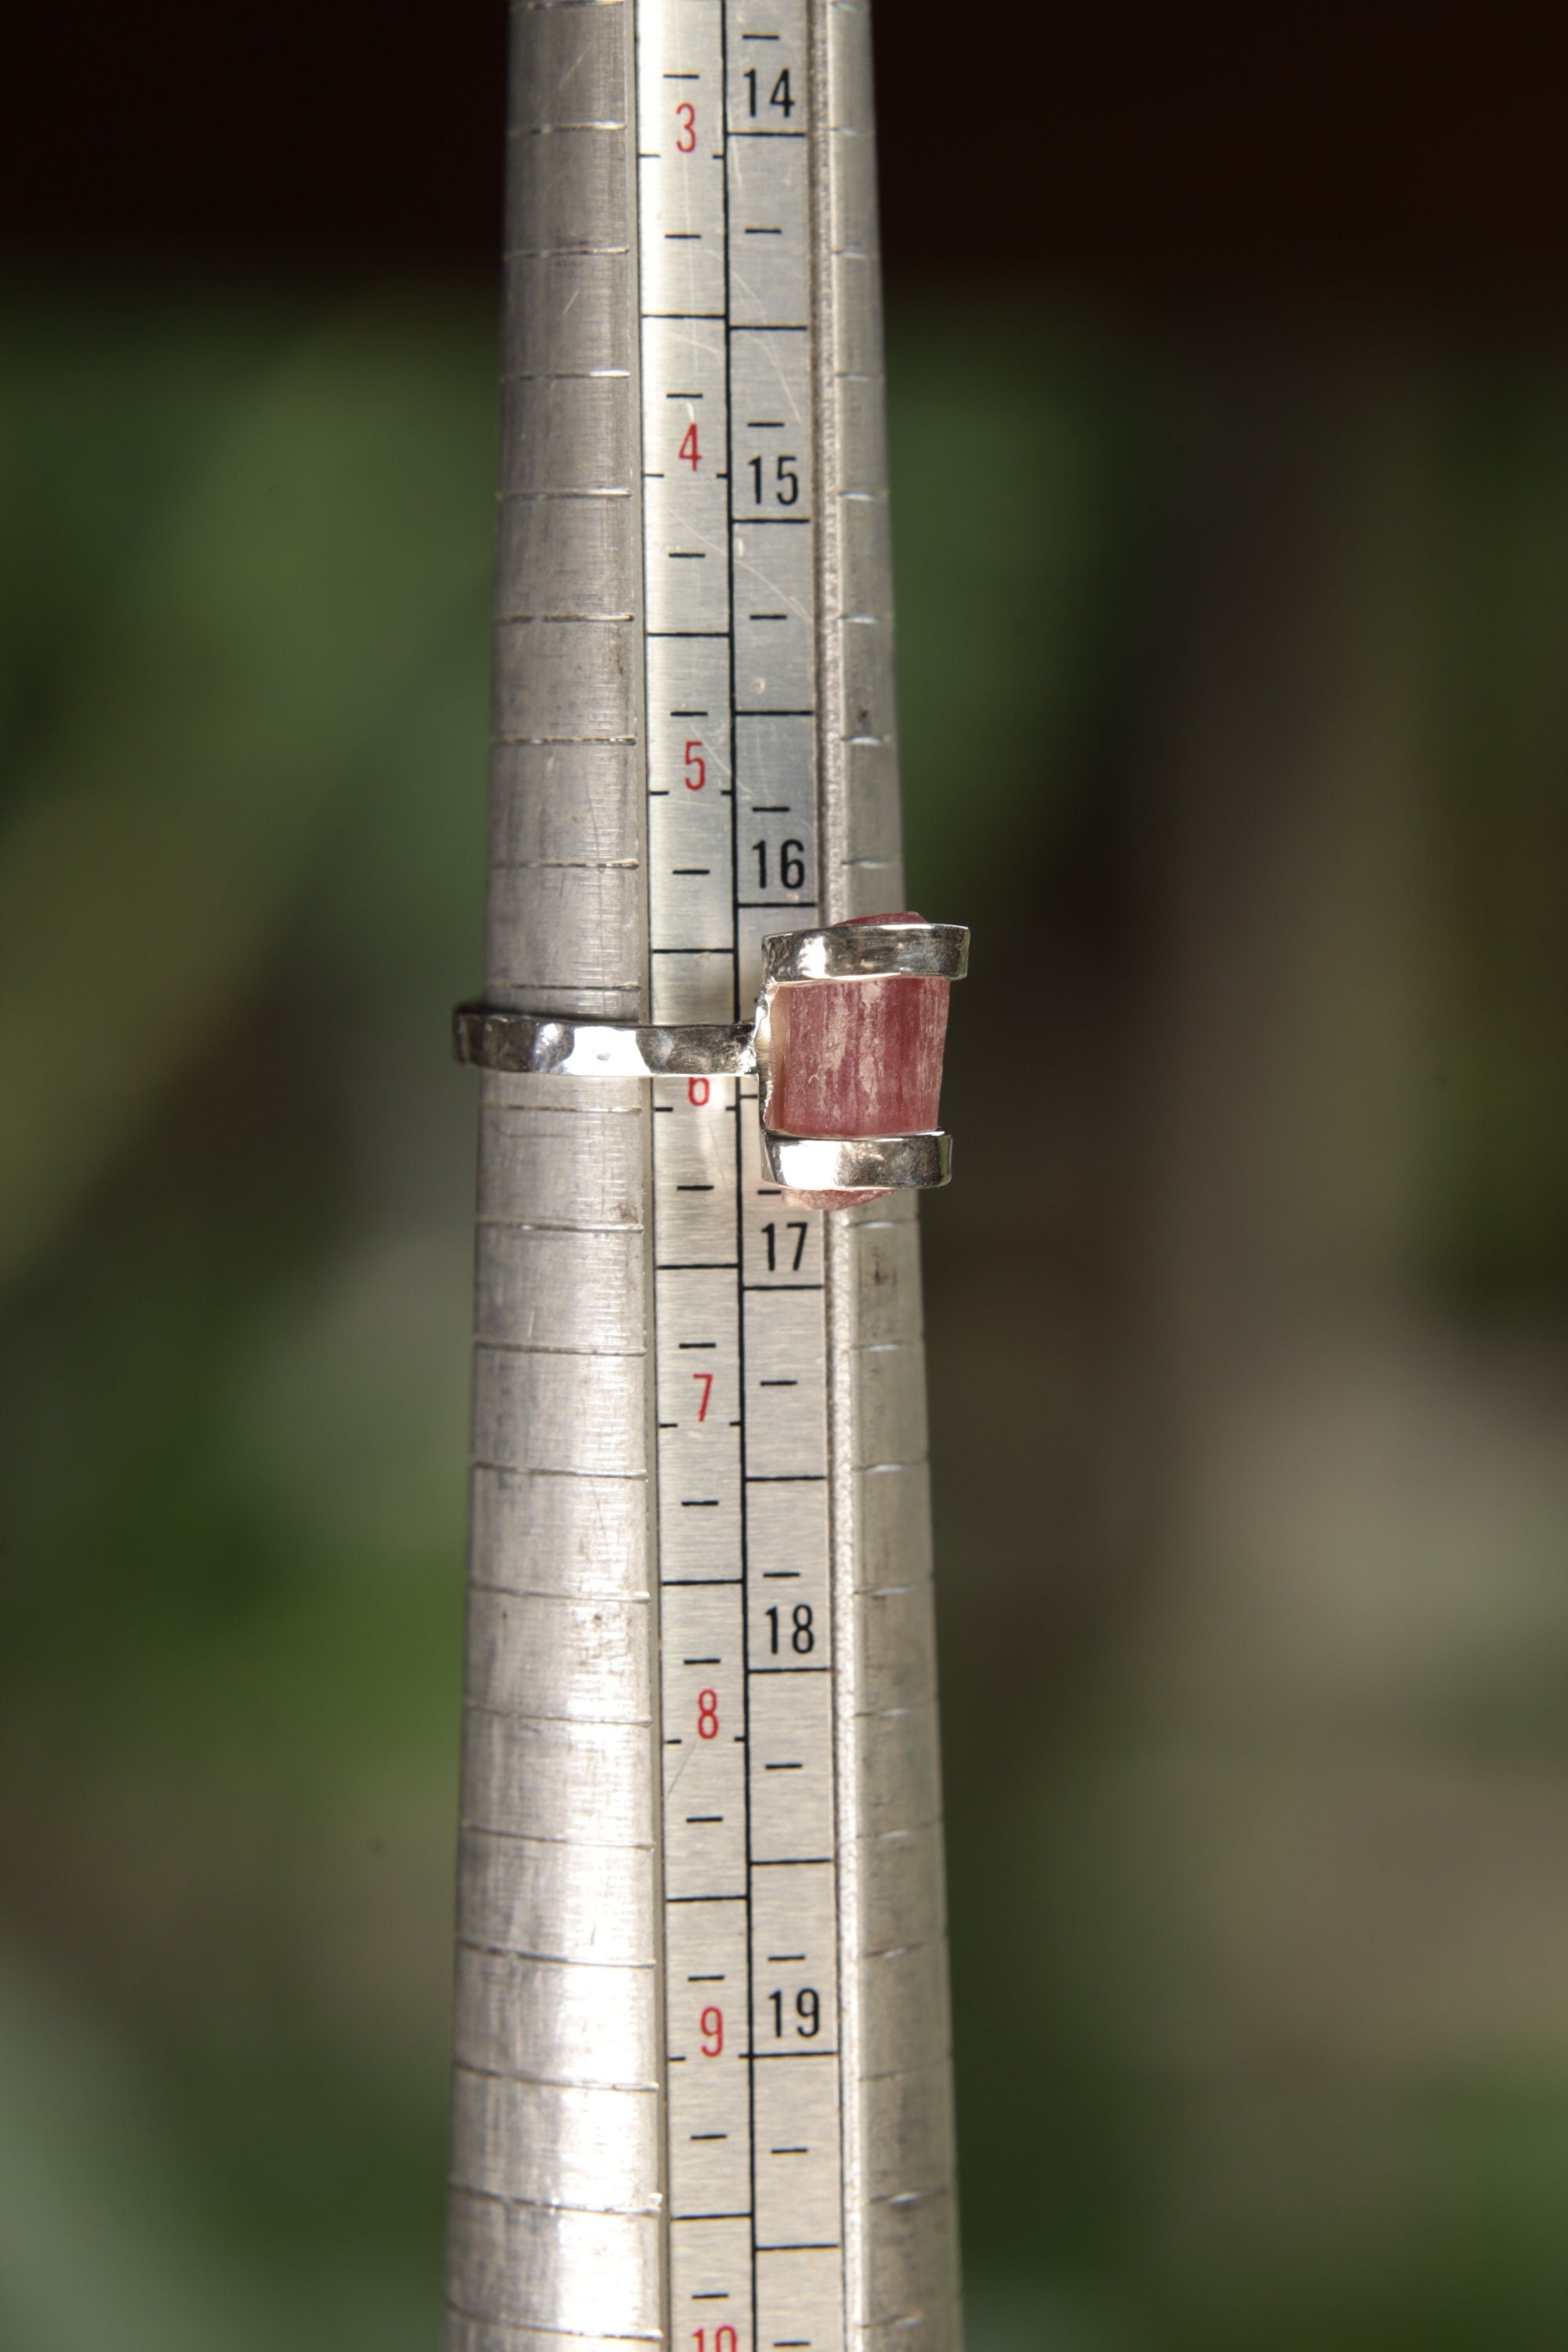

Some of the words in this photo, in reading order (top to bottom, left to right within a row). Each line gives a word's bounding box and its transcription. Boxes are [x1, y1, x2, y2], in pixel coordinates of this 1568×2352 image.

[743, 67, 796, 118] 14
[675, 101, 698, 153] 3
[677, 423, 702, 472] 4
[747, 456, 800, 506] 15
[684, 740, 706, 792] 5
[751, 837, 806, 891] 16
[760, 1221, 808, 1272] 17
[692, 1372, 714, 1423] 7
[764, 1604, 815, 1654] 18
[696, 1688, 720, 1740] 8
[699, 2005, 724, 2058] 9
[768, 1988, 821, 2038] 19
